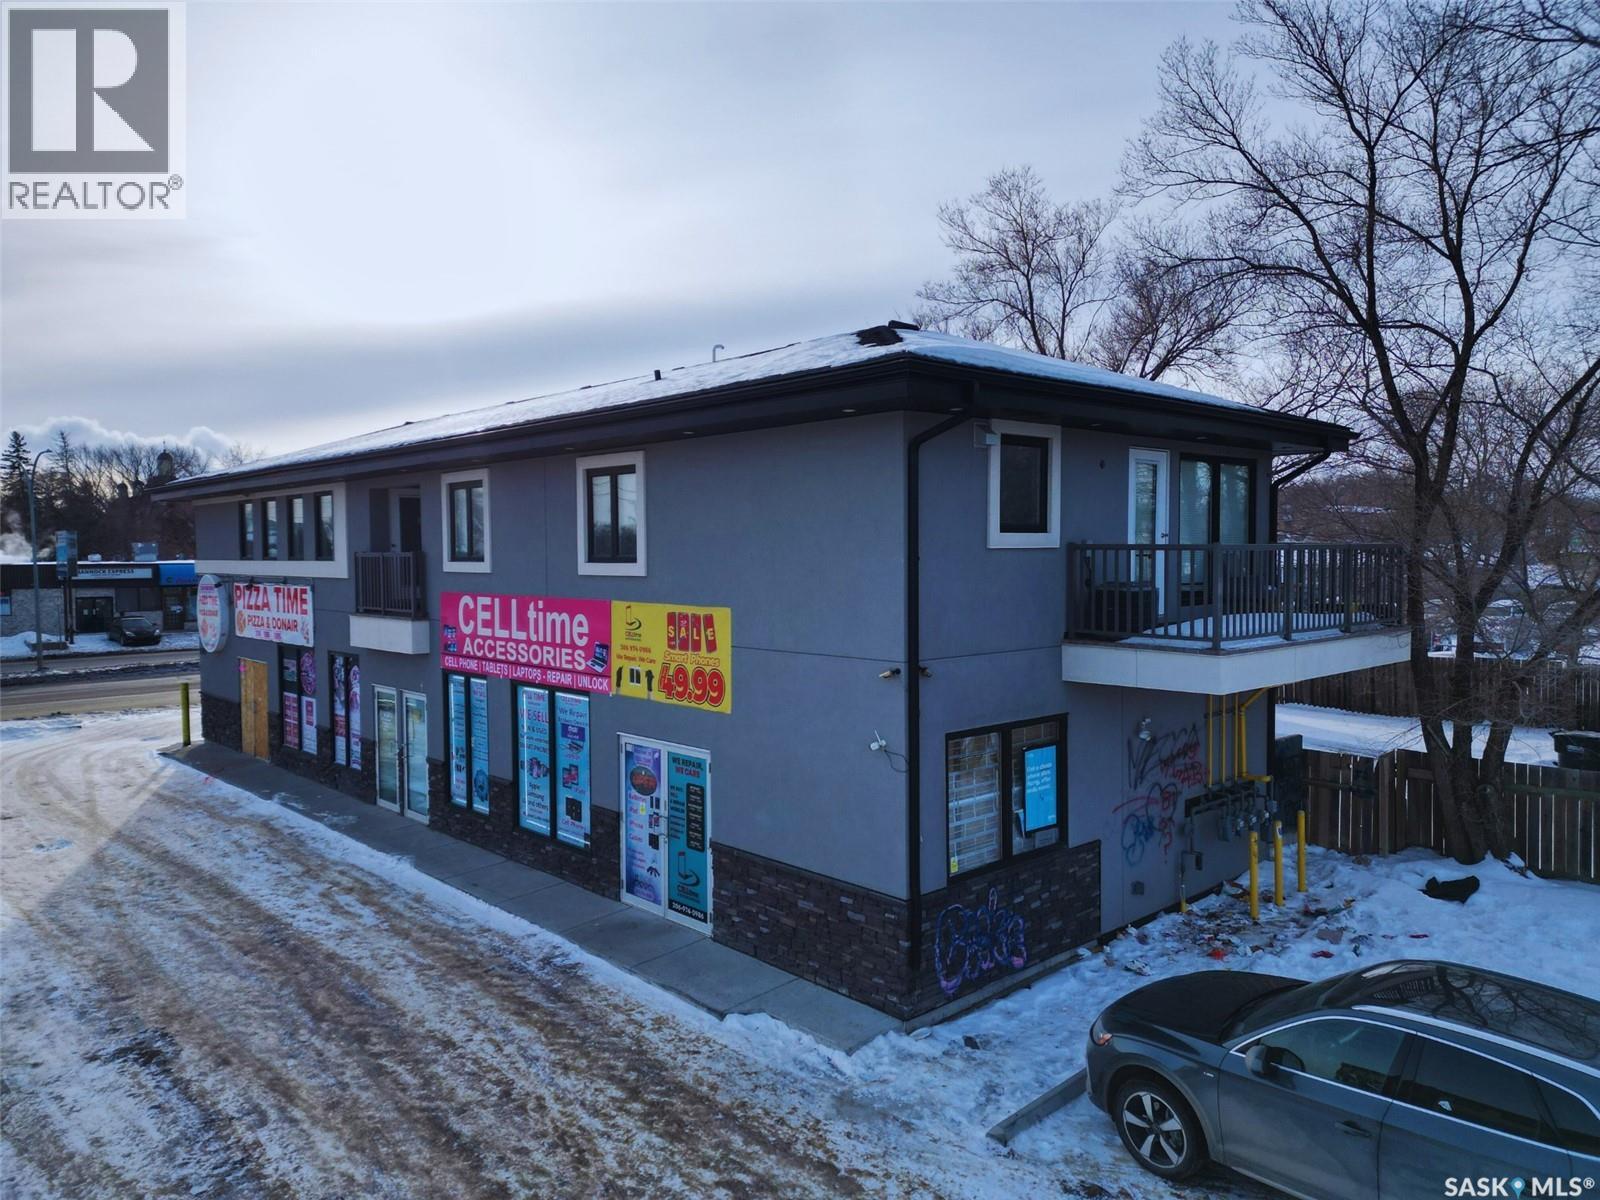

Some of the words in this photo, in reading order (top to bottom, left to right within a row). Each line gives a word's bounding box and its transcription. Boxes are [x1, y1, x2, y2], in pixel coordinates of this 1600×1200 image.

[234, 584, 271, 611] PIZZA
[273, 586, 308, 615] TIME
[247, 615, 265, 628] PIZZA
[272, 617, 298, 632] DONAIR
[458, 595, 590, 647] CELLtime
[462, 637, 587, 671] ACCESSORIES
[444, 658, 459, 668] CELL
[458, 659, 479, 672] PHONE
[482, 662, 509, 677] TABLETS
[512, 666, 542, 682] LAPTOPS
[546, 670, 573, 685] REPAIR
[577, 675, 609, 691] UNLOCK
